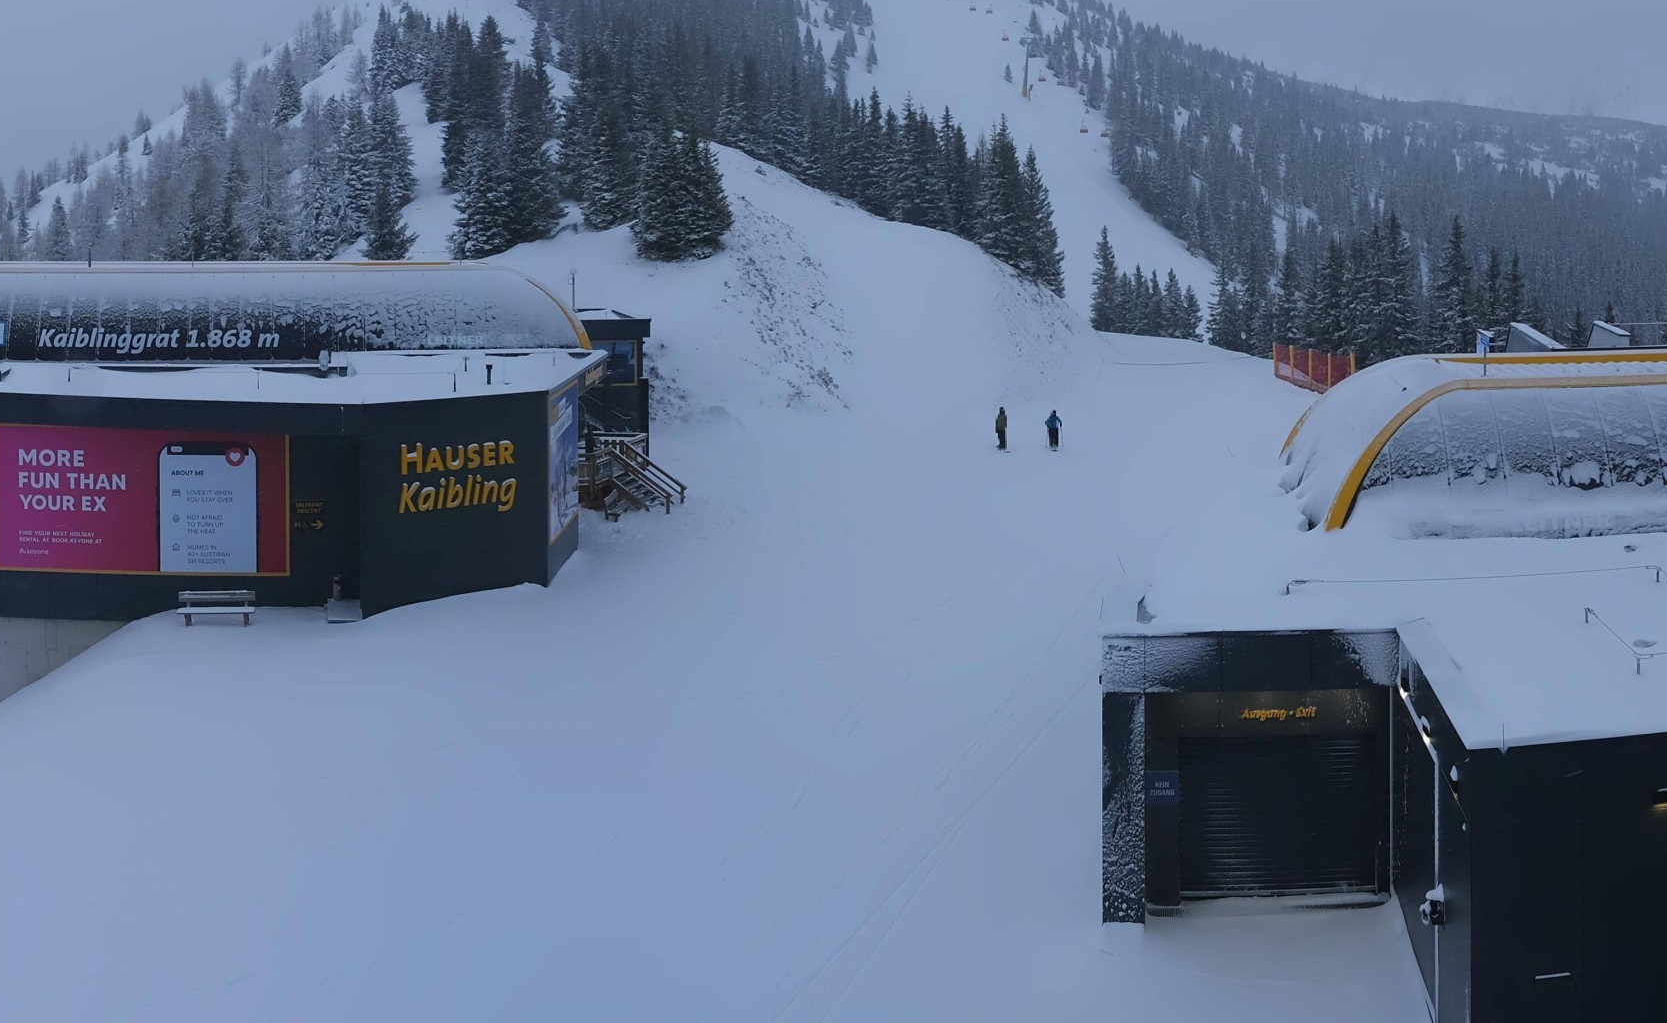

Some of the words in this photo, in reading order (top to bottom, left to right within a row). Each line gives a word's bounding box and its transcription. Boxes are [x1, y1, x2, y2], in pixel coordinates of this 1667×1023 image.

[38, 328, 180, 354] Kaiblinggrat
[185, 329, 252, 348] 1.868
[257, 333, 280, 348] m
[18, 449, 84, 467] MORE
[400, 440, 514, 475] HAUSER
[18, 472, 59, 488] FUN
[66, 473, 126, 490] THAN
[20, 494, 75, 511] YOUR
[81, 496, 107, 511] EX
[399, 474, 517, 513] Kaibling
[1241, 708, 1288, 722] Ausgang
[1150, 788, 1175, 796] ZUGANG
